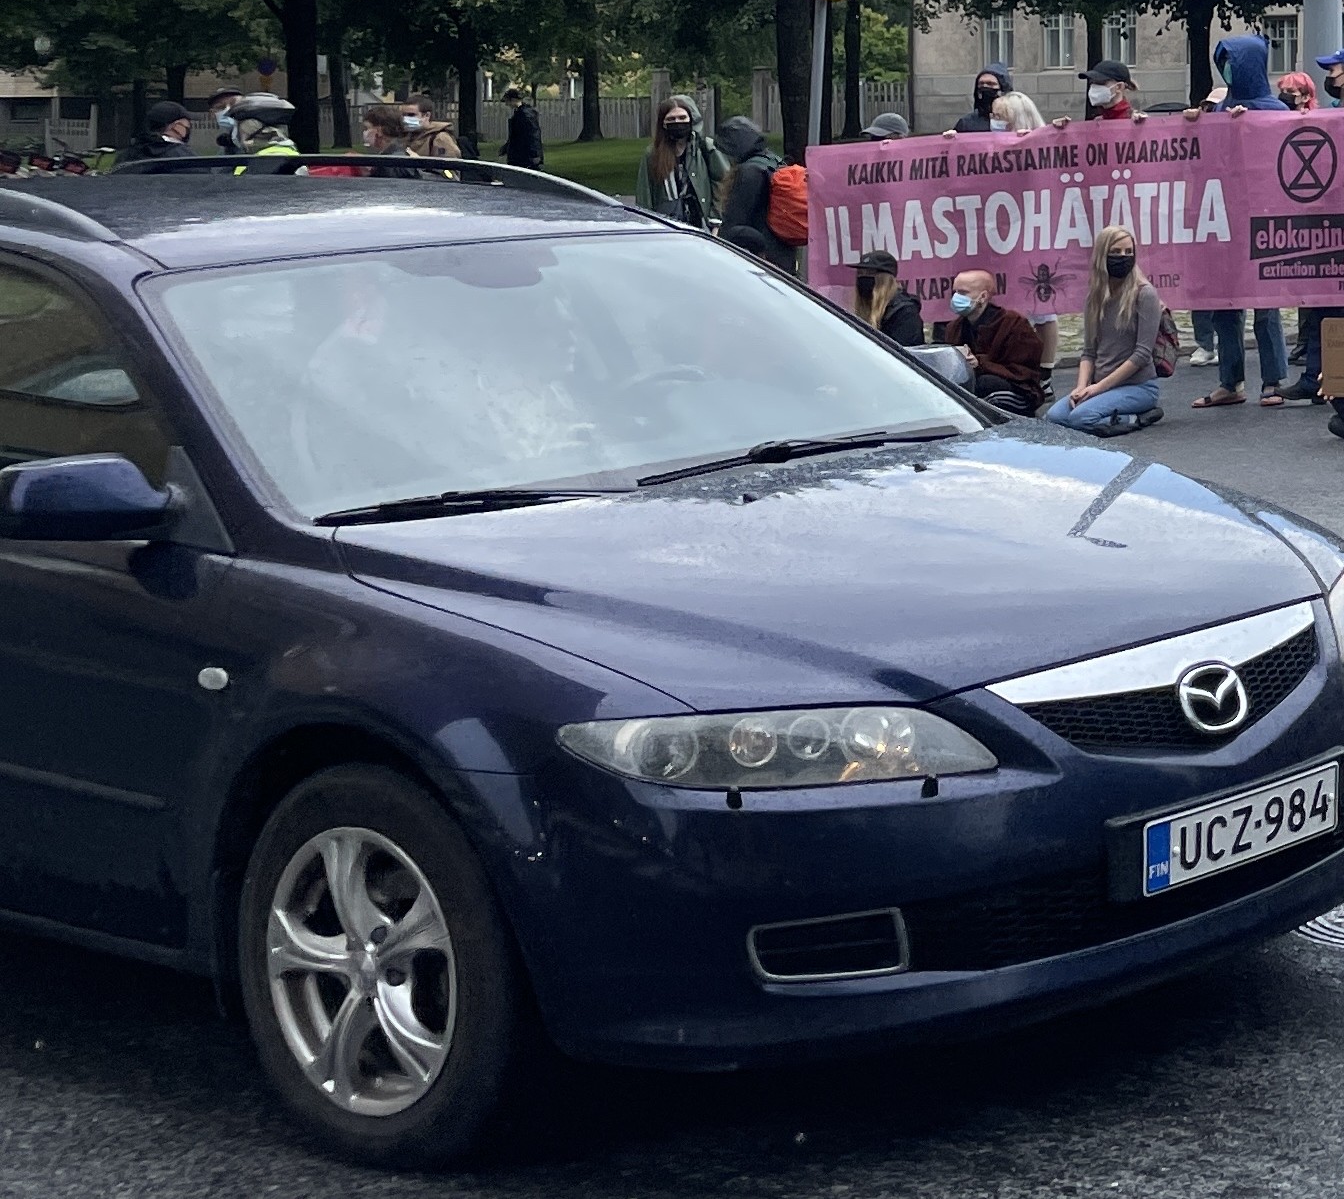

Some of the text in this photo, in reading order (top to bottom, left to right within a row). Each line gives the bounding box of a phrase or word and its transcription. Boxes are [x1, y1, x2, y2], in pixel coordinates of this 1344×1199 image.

[848, 137, 1201, 186] KAIKKI MITÄ RAKASTAMME ON VAARASSA
[824, 168, 1232, 266] ILMASTOHÄTÄTILA
[1262, 261, 1316, 278] extinction
[1179, 779, 1329, 871] UCZ-984
[1148, 860, 1169, 879] FIN
